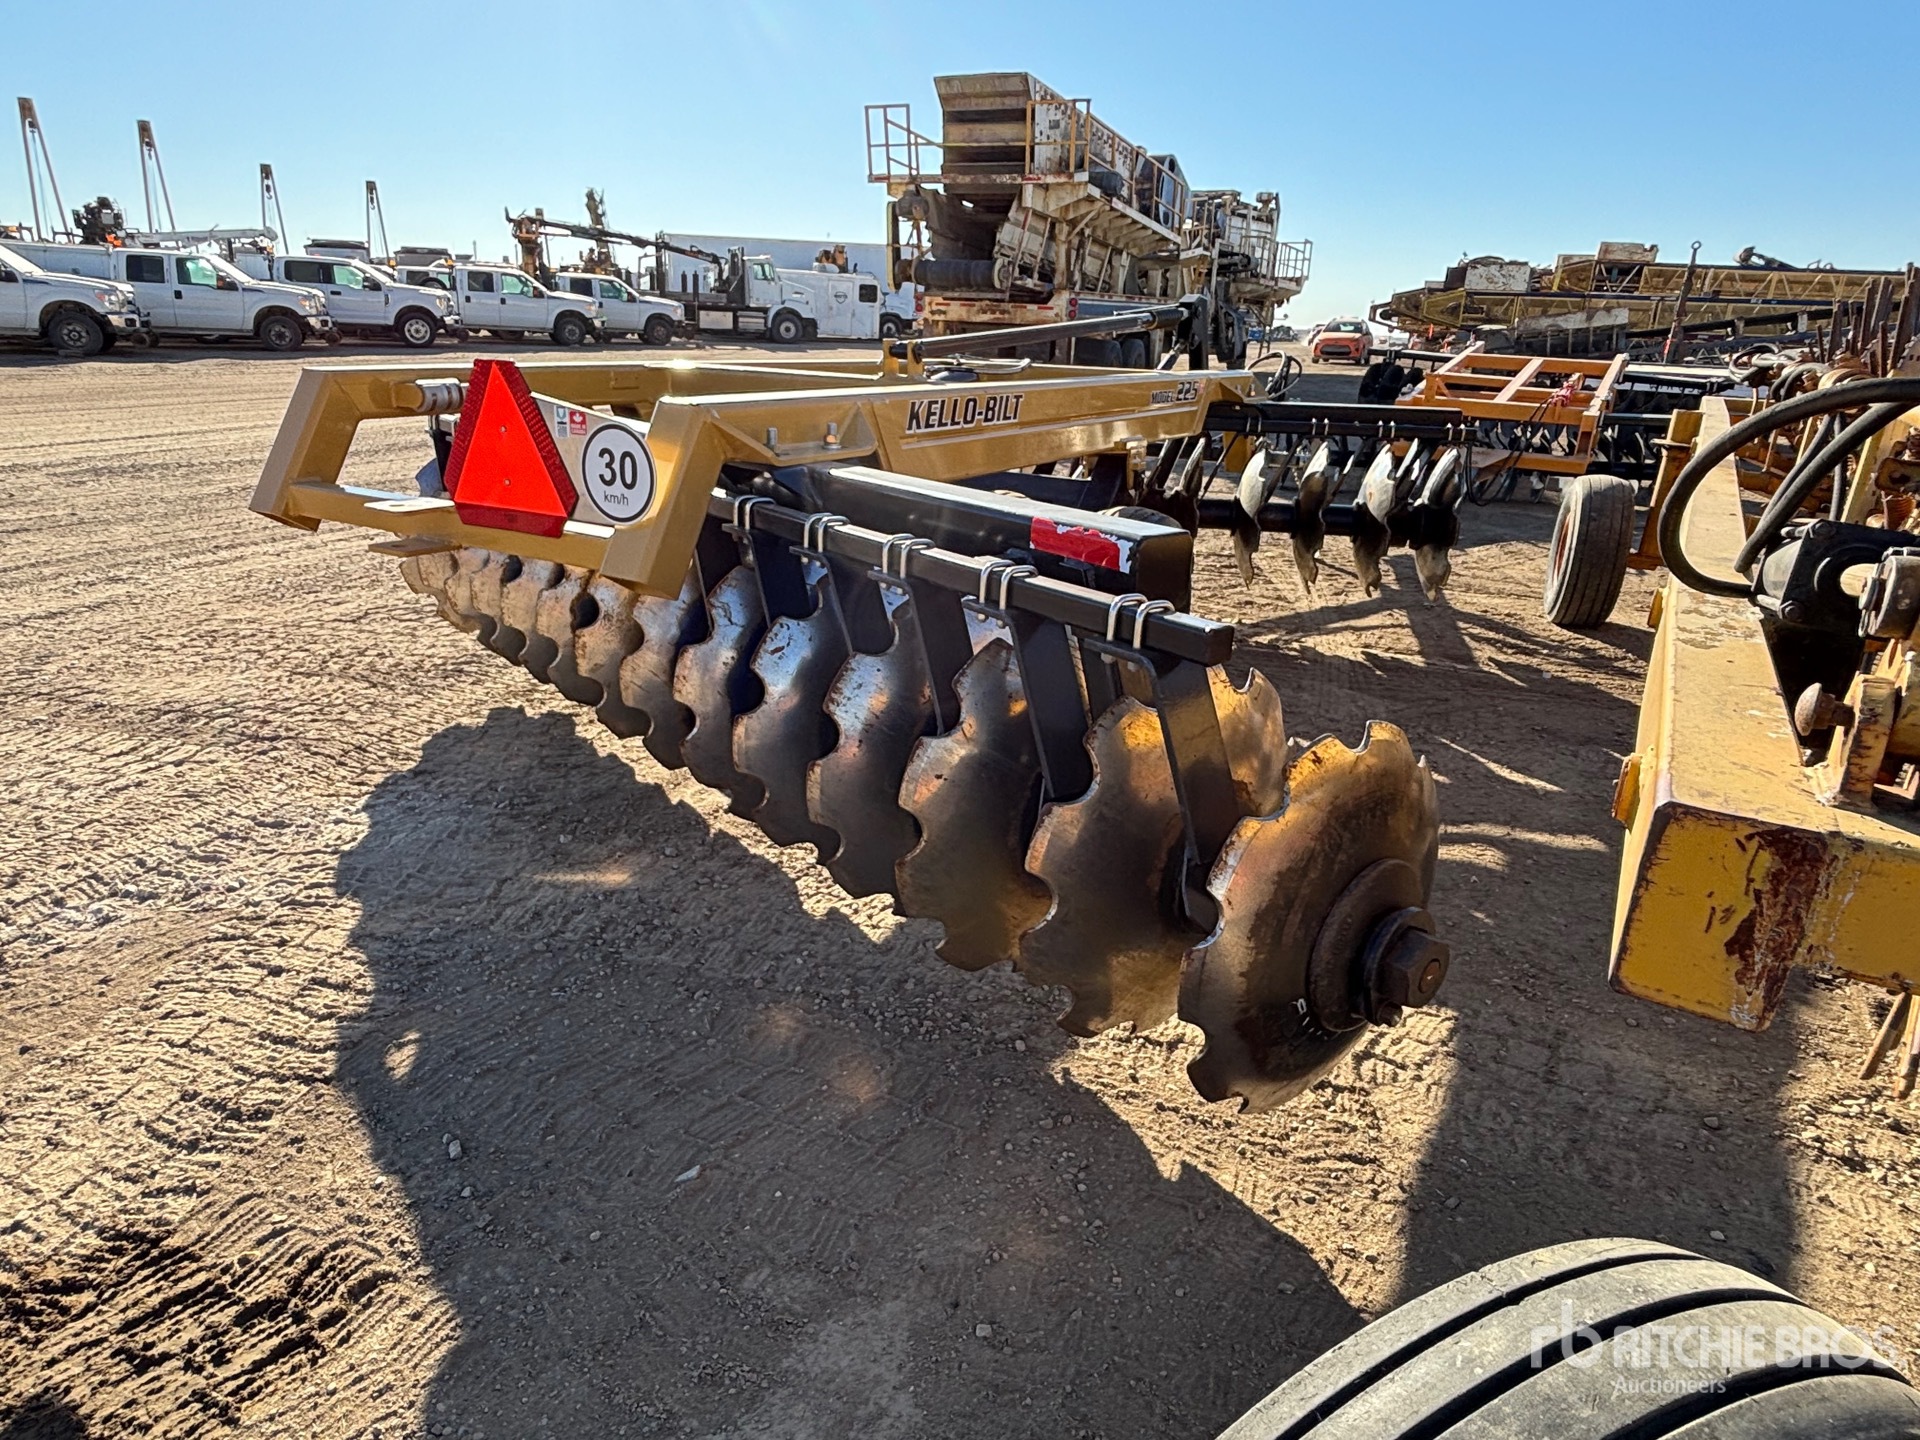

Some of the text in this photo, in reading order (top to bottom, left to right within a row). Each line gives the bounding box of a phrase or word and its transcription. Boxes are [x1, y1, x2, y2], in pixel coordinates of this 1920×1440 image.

[1176, 381, 1199, 402] 225
[906, 394, 1024, 433] KELLO-BILT
[598, 447, 638, 490] 30
[604, 490, 629, 506] km/h
